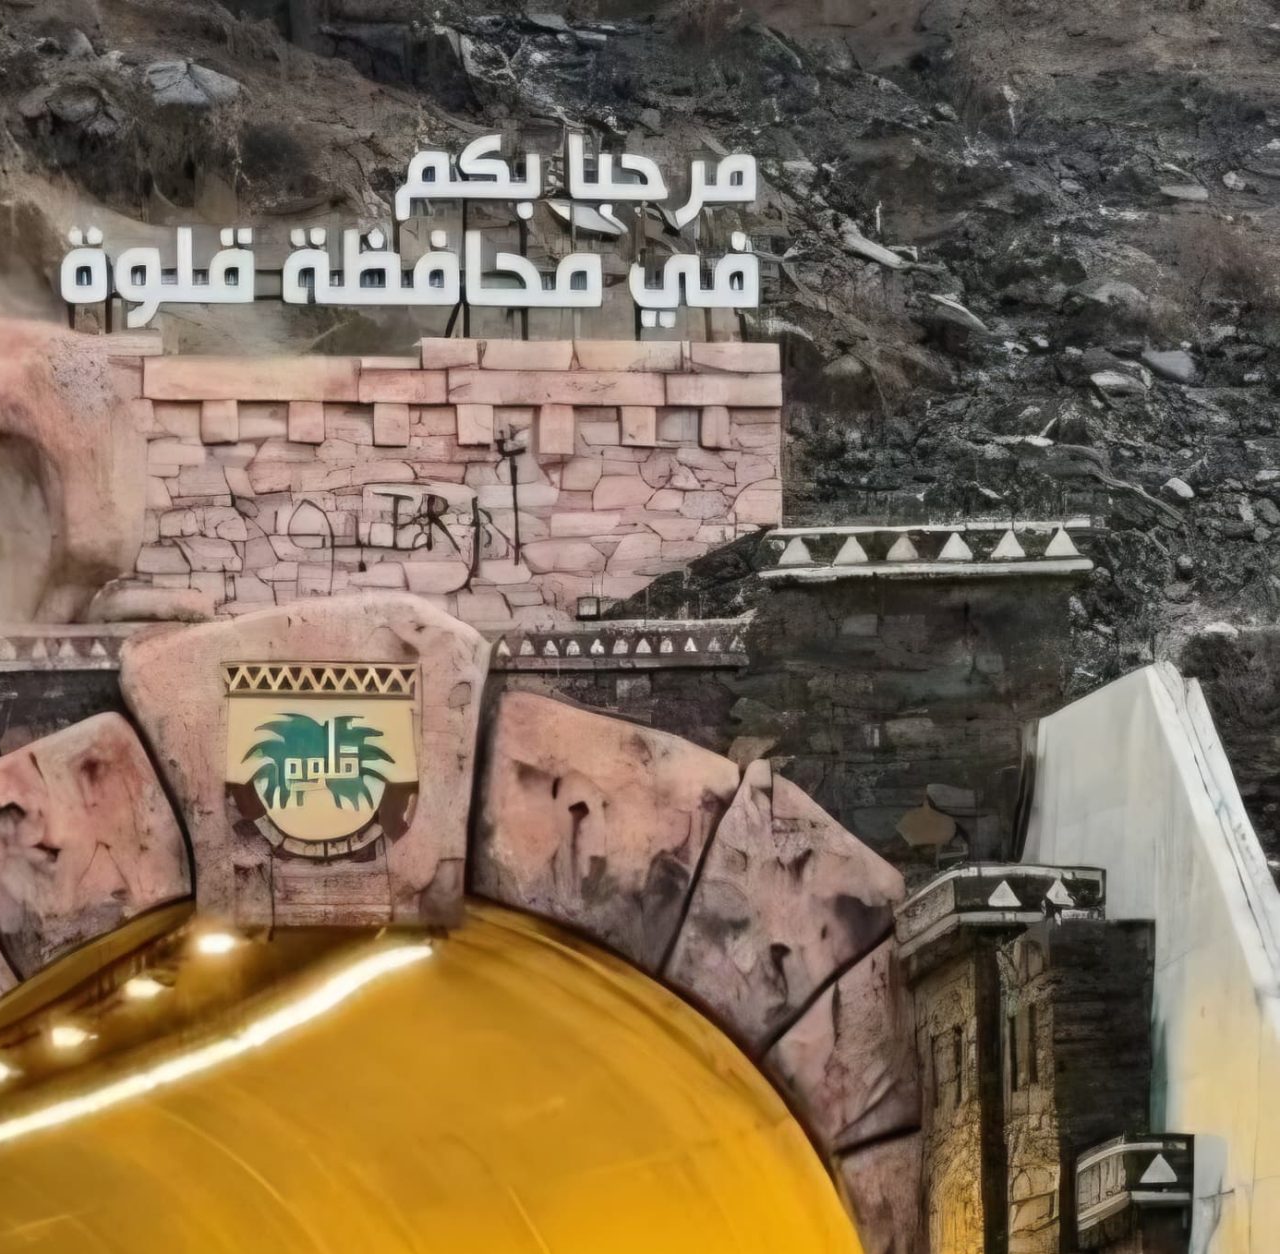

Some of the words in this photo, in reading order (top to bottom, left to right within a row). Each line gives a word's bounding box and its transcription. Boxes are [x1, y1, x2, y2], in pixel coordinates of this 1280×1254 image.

[396, 134, 541, 220] بكم
[569, 133, 757, 229] مرحبا
[60, 226, 255, 328] قلوة
[283, 227, 602, 307] محافظة
[629, 231, 759, 328] في
